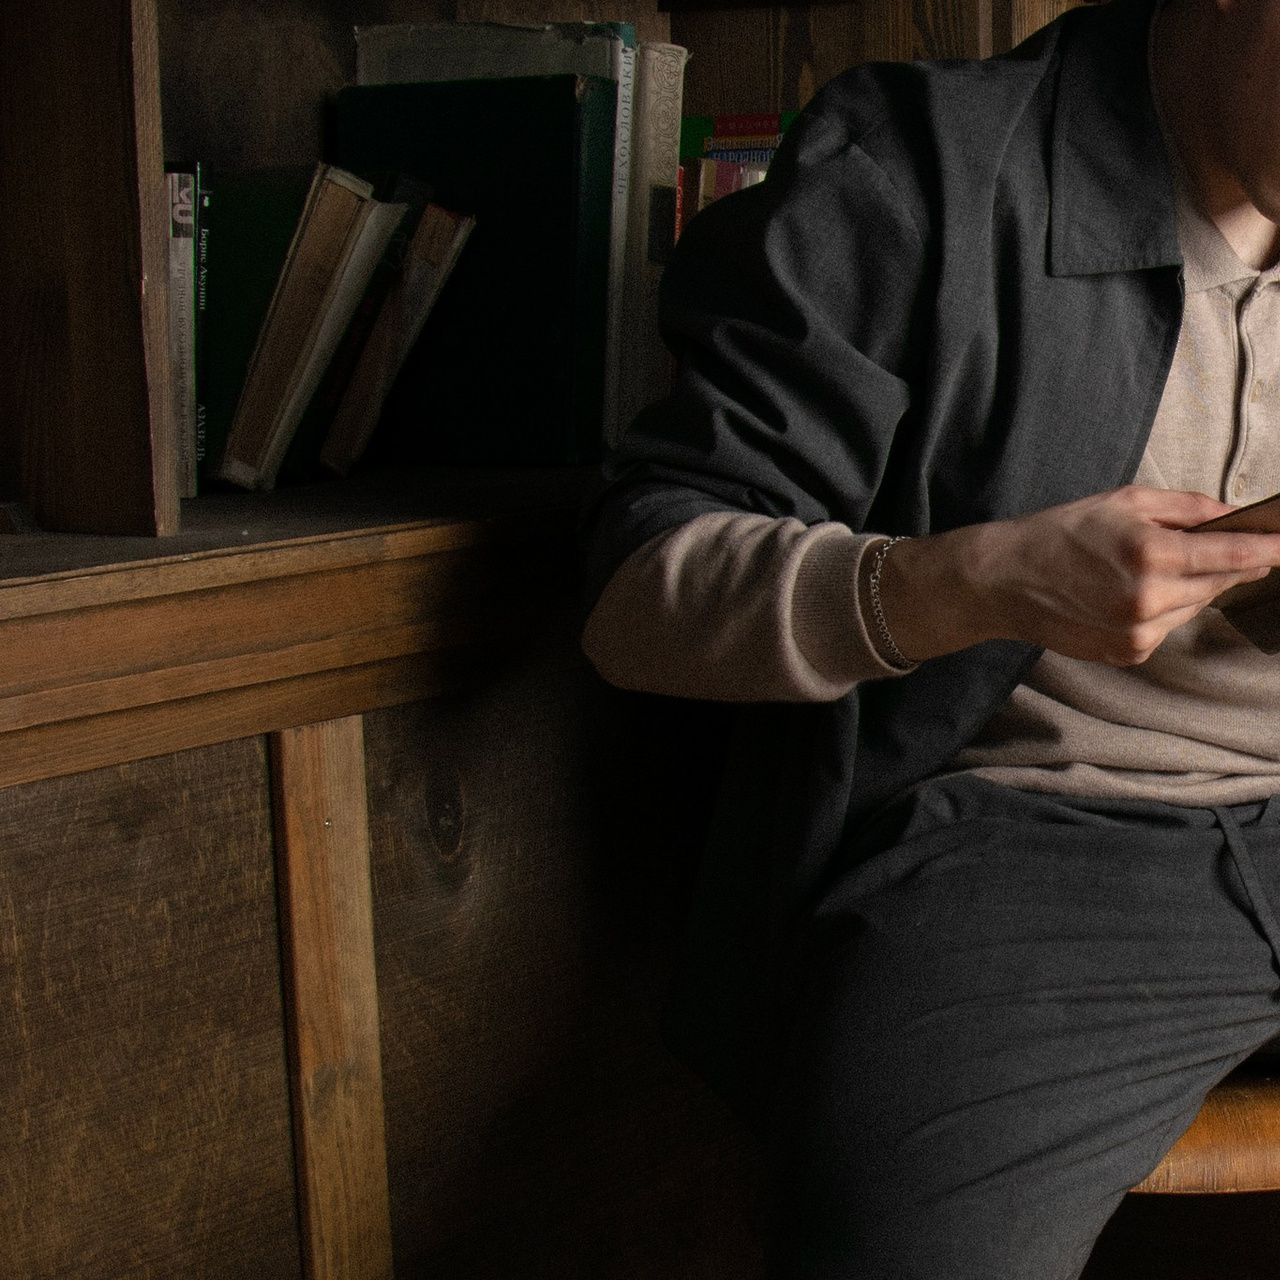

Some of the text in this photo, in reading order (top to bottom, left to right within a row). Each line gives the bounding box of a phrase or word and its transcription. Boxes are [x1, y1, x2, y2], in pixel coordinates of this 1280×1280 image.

[197, 227, 209, 310] Борис Акунин
[195, 403, 206, 461] АЗАЗЕЛЬ
